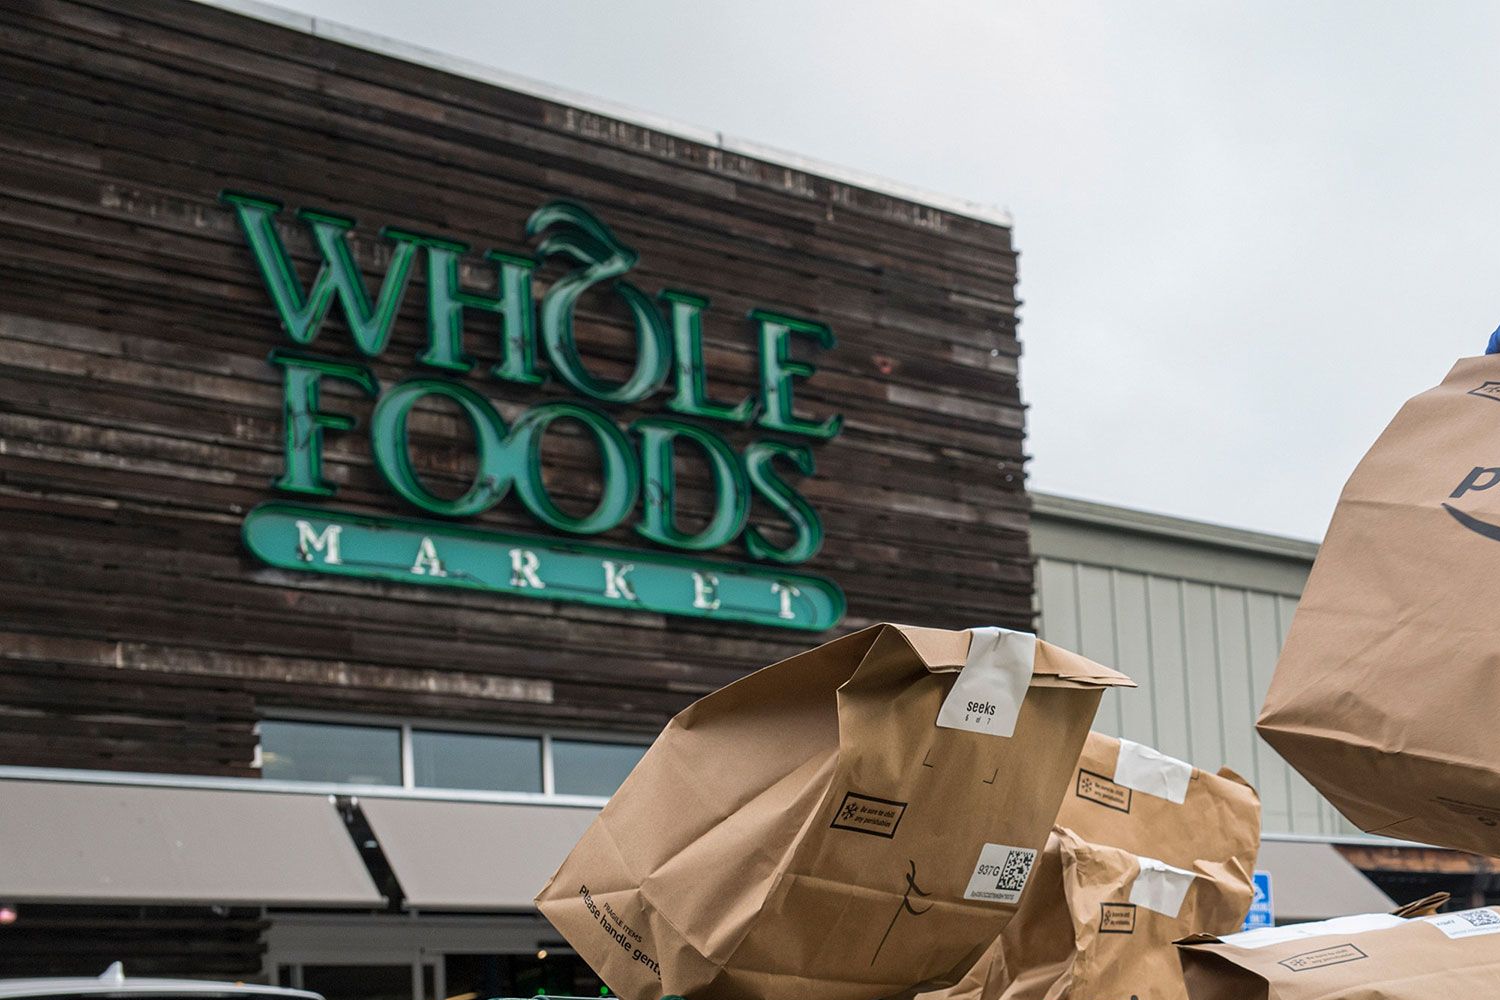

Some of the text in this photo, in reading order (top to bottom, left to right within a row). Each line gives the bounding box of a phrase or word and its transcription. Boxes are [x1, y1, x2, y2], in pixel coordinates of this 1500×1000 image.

[218, 189, 844, 438] WHOLE
[267, 347, 822, 564] FOODS
[295, 519, 802, 620] MARKET
[966, 701, 996, 716] seeks
[977, 864, 1000, 877] 937G
[579, 884, 600, 919] Please
[600, 914, 632, 952] handle
[603, 902, 642, 943] FRAGILE ITEMS
